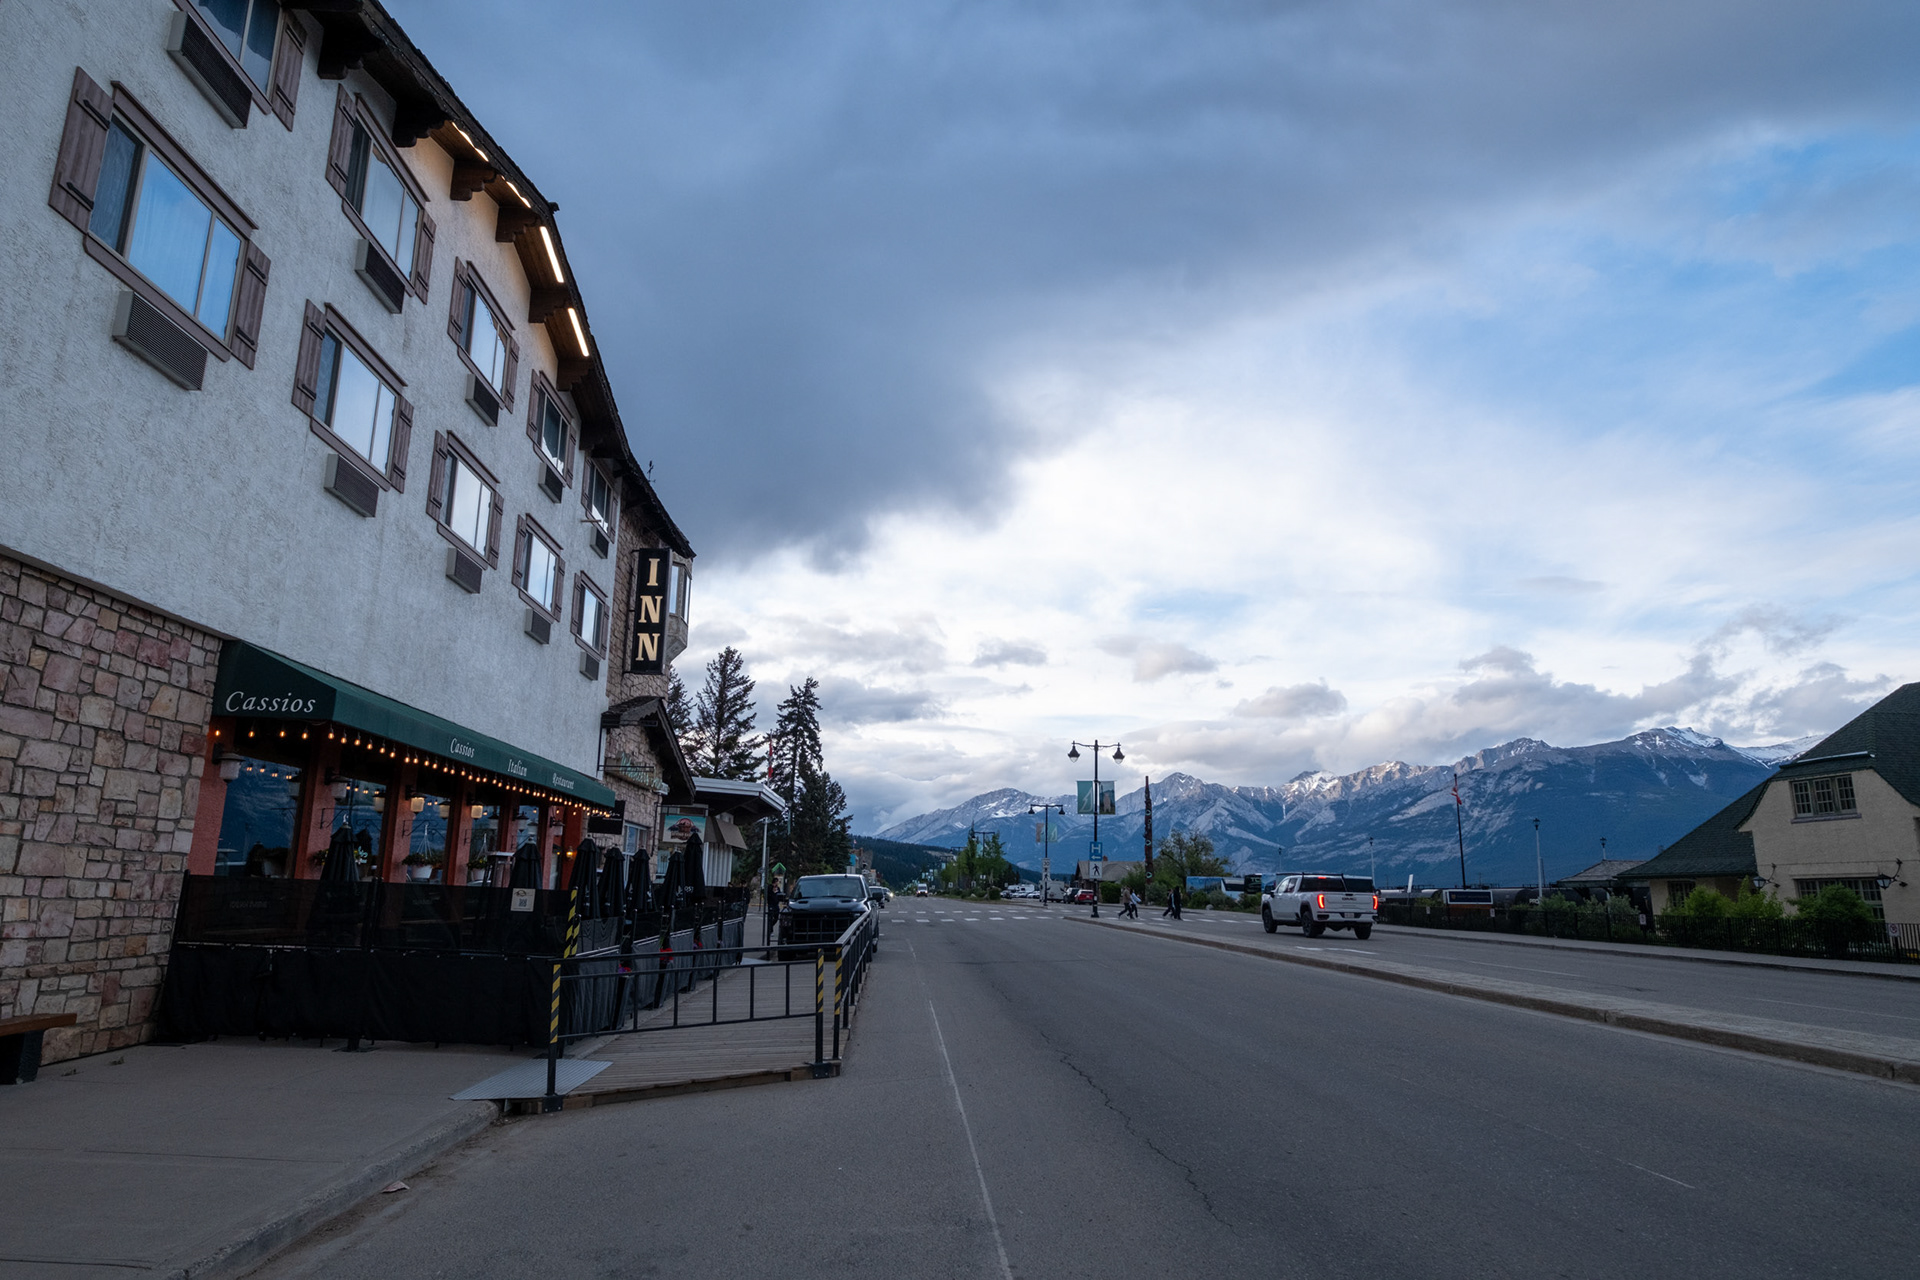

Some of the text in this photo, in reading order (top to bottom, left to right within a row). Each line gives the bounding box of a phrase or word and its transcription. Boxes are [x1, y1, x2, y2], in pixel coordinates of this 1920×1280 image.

[635, 558, 663, 661] INN
[225, 691, 316, 713] Cassios
[450, 738, 575, 790] Cassios Italian Restaurant
[1091, 843, 1101, 854] H
